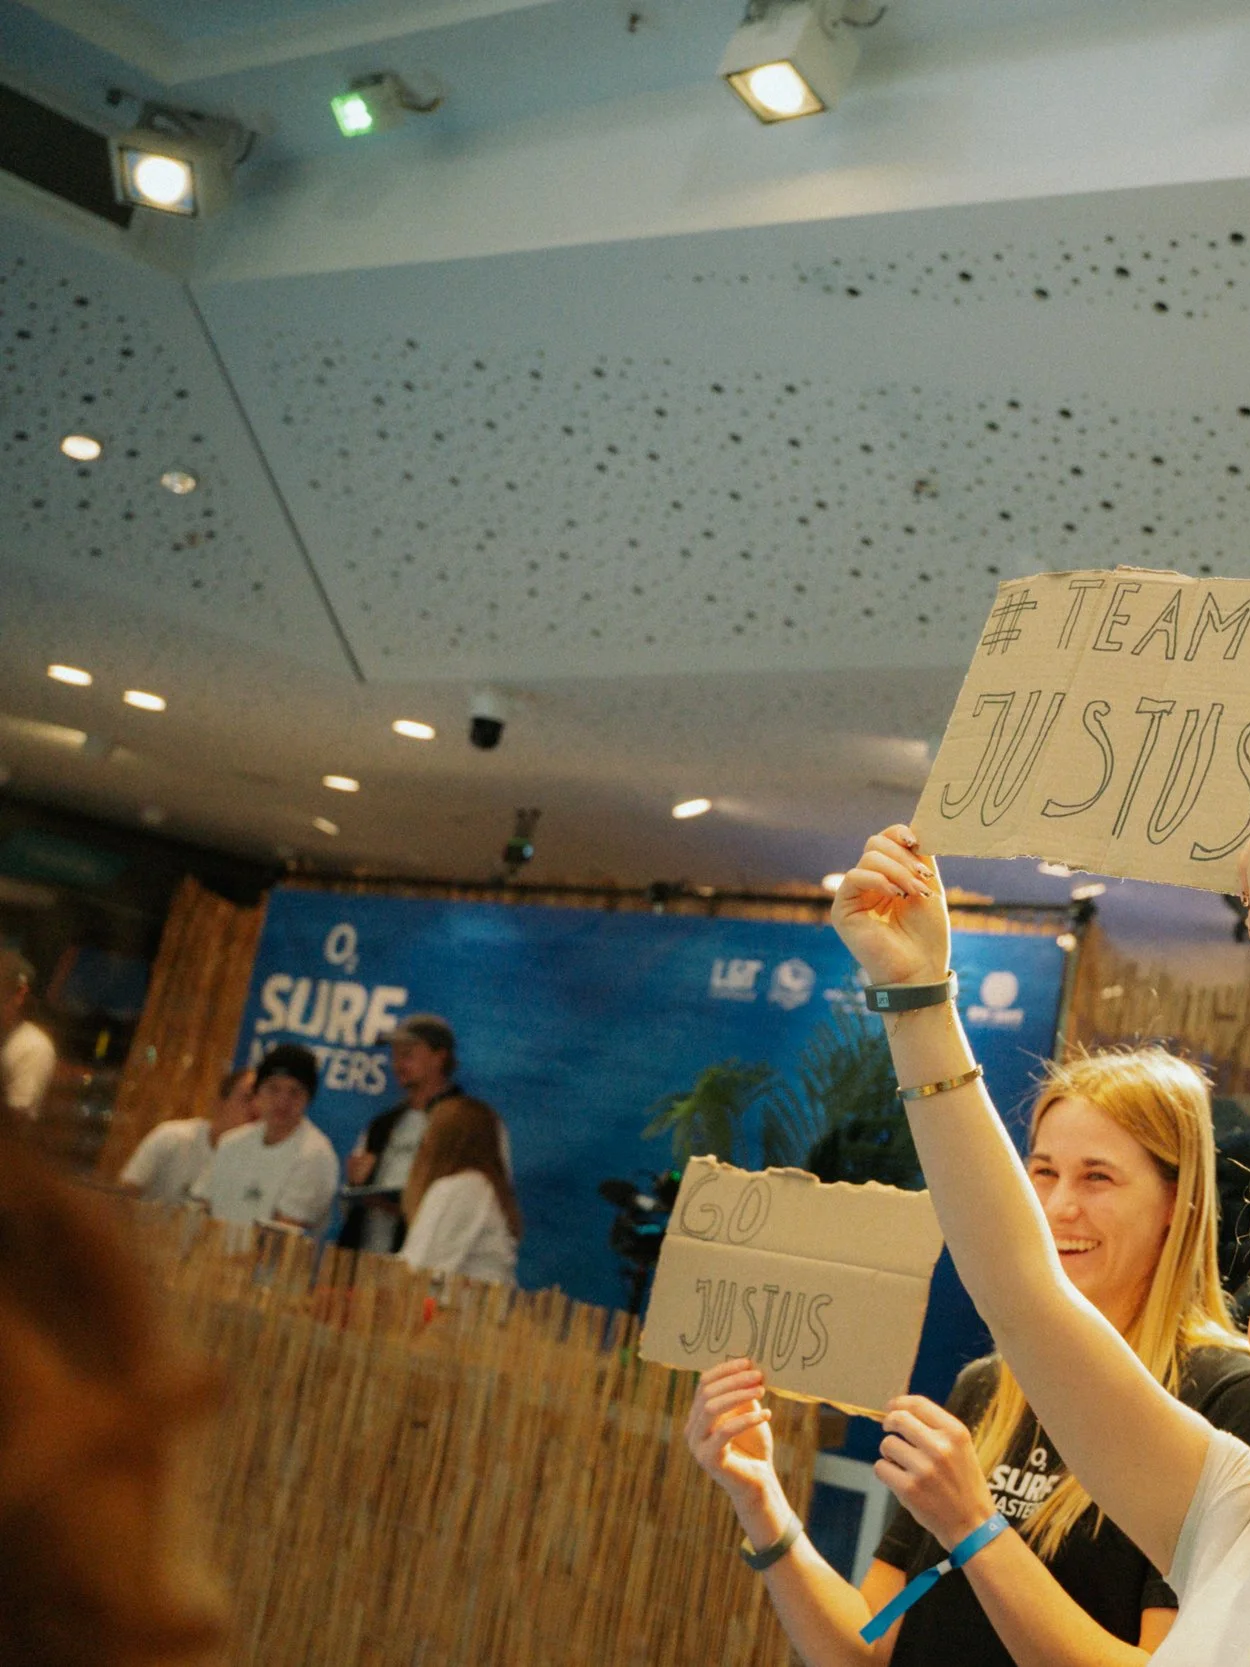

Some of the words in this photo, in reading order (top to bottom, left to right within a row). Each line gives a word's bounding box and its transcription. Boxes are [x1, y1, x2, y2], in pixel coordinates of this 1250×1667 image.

[255, 973, 409, 1047] SURF
[680, 1172, 771, 1245] GO
[679, 1278, 833, 1372] JUSTUS
[987, 1464, 1062, 1502] SURF
